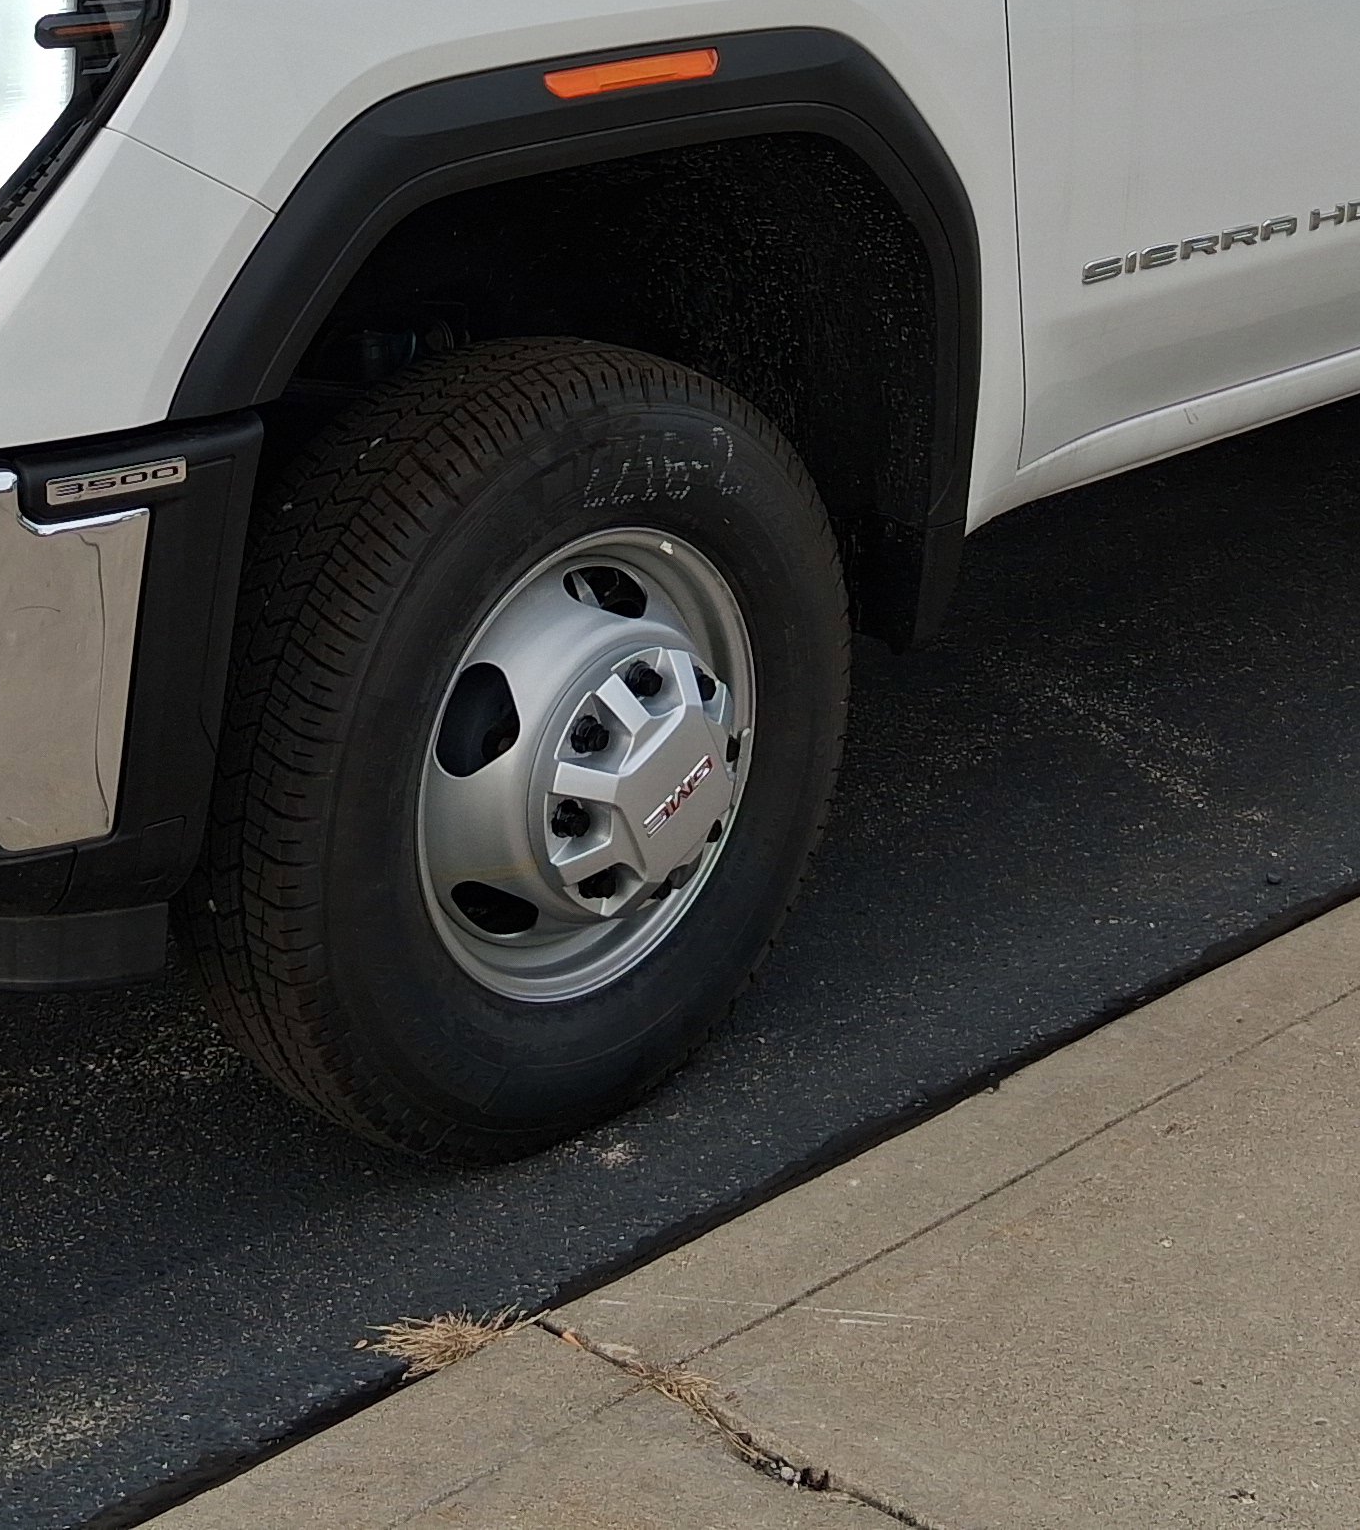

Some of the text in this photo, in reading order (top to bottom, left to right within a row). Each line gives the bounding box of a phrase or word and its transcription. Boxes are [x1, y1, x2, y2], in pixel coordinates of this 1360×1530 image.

[1081, 214, 1298, 286] SIERRA
[54, 465, 180, 497] 3500
[643, 753, 714, 840] GMC
